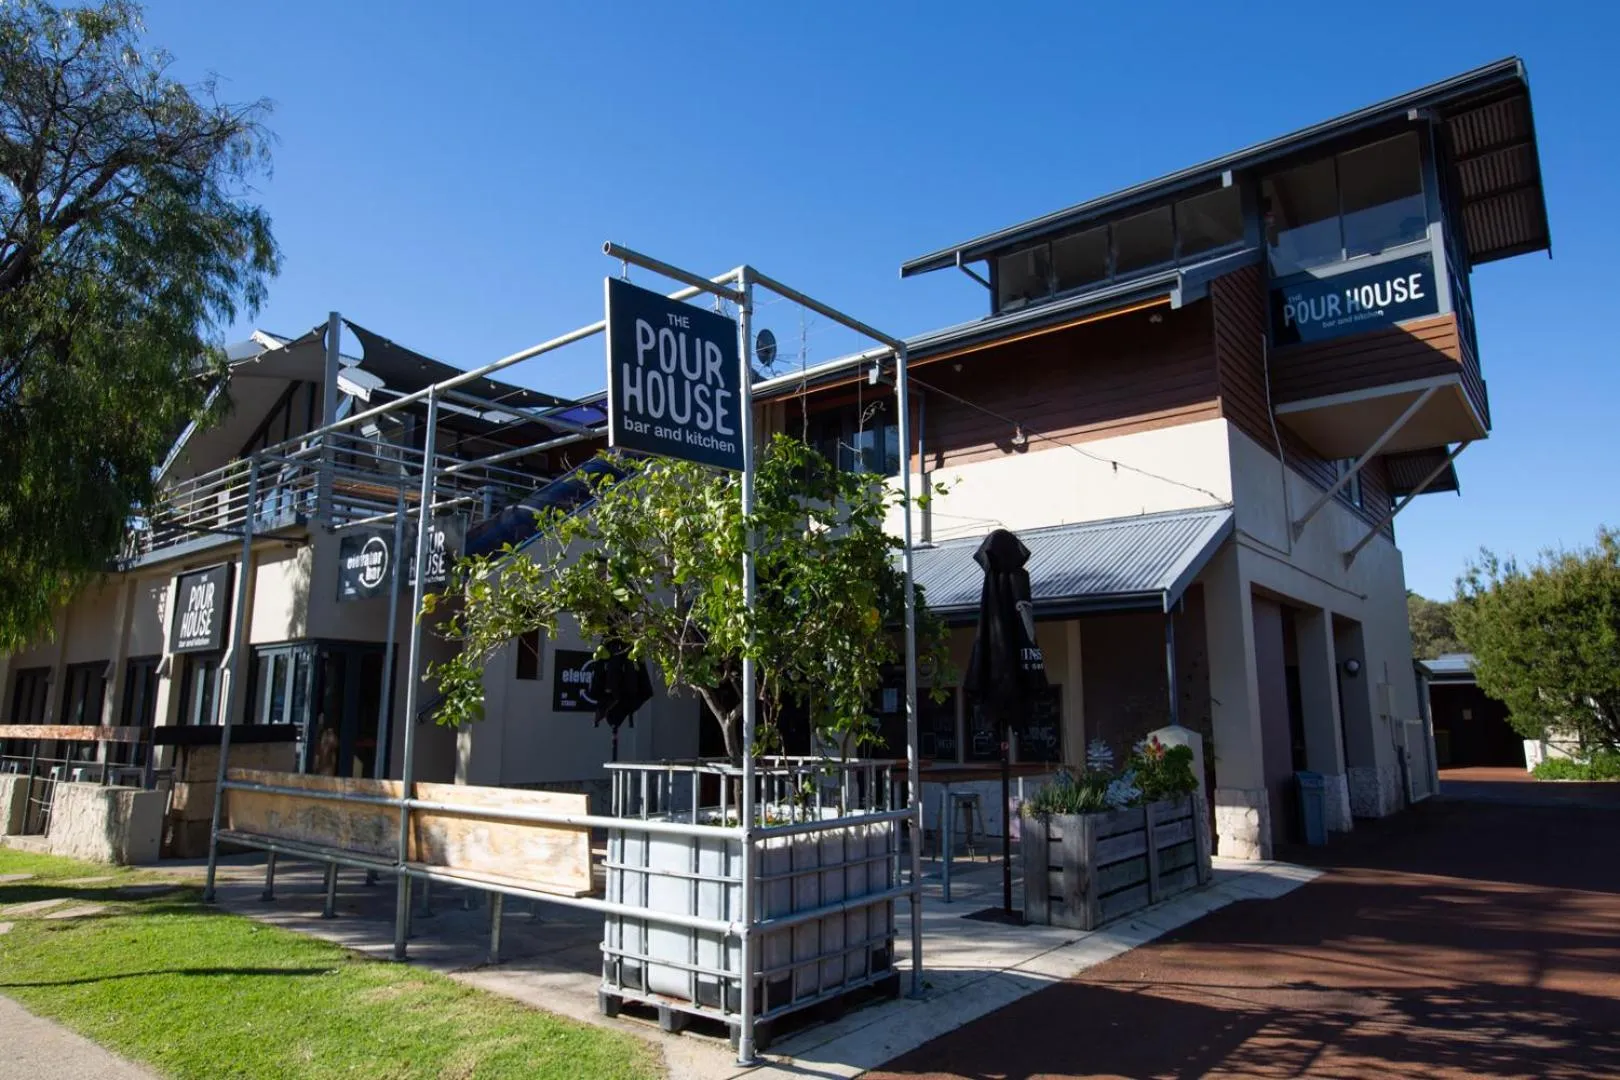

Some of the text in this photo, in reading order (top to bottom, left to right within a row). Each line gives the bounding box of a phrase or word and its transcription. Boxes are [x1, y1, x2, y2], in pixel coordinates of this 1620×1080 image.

[1283, 273, 1425, 327] POUR HOUSE
[667, 313, 690, 328] THE
[1322, 318, 1336, 329] bar
[1337, 315, 1353, 326] and
[635, 317, 726, 389] POUR
[622, 362, 736, 436] HOUSE
[623, 415, 736, 454] bar and kitchen
[188, 582, 214, 611] POUR
[179, 607, 214, 639] HOUSE
